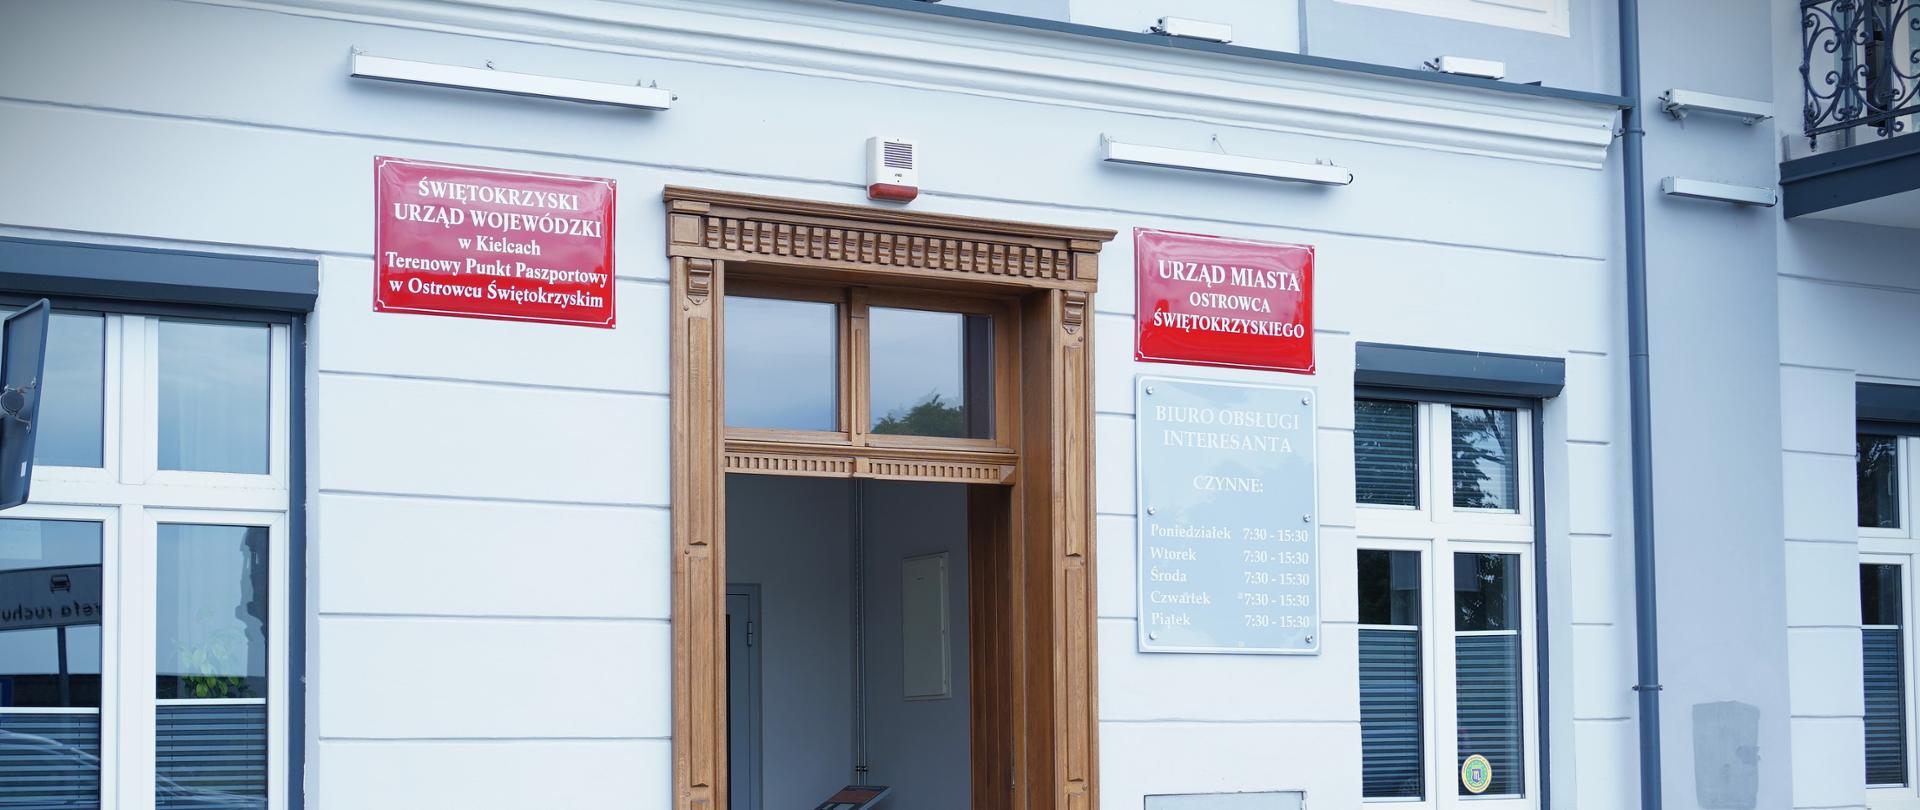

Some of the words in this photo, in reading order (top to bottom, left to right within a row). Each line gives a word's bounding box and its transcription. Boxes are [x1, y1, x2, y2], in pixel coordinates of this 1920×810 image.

[418, 176, 579, 211] ŚWIĘTOKRZYSKI
[393, 203, 465, 229] URZĄD
[469, 208, 602, 238] WOJEWÓDZKI
[458, 238, 472, 249] w
[476, 235, 541, 256] Kielcach
[385, 251, 461, 275] Terenowy
[465, 258, 512, 277] Punkt
[515, 262, 608, 287] Paszportowy
[1158, 260, 1226, 288] URZĄD
[1231, 266, 1300, 292] MIASTA
[389, 281, 404, 292] w
[407, 277, 482, 298] Ostrowcu
[487, 280, 604, 309] Świętokrzyskim
[1189, 292, 1271, 313] OSTROWCA
[1153, 308, 1305, 339] ŚWIĘTOKRZYSKIEGO
[1155, 405, 1214, 425] BIURO
[1219, 409, 1300, 430] OBSŁUGI
[1163, 429, 1293, 453] INTERESANTA
[1193, 475, 1264, 493] CZYNNE:
[1151, 523, 1232, 540] Poniedziałek
[1242, 528, 1267, 541] 7:30
[1278, 530, 1308, 543] 15:30
[1150, 546, 1197, 561] Wtorek
[1243, 550, 1267, 563] 7:30
[1279, 552, 1309, 565] 15:30
[1150, 566, 1187, 582] Środa
[1244, 572, 1268, 585] 7:30
[1280, 573, 1309, 586] 15:30
[1150, 590, 1211, 605] Czwartek
[1244, 593, 1269, 606] 7:30
[1280, 594, 1309, 607] 15:30
[1151, 612, 1191, 628] Piątek
[1245, 614, 1269, 627] 7:30
[1280, 616, 1310, 628] 15:30
